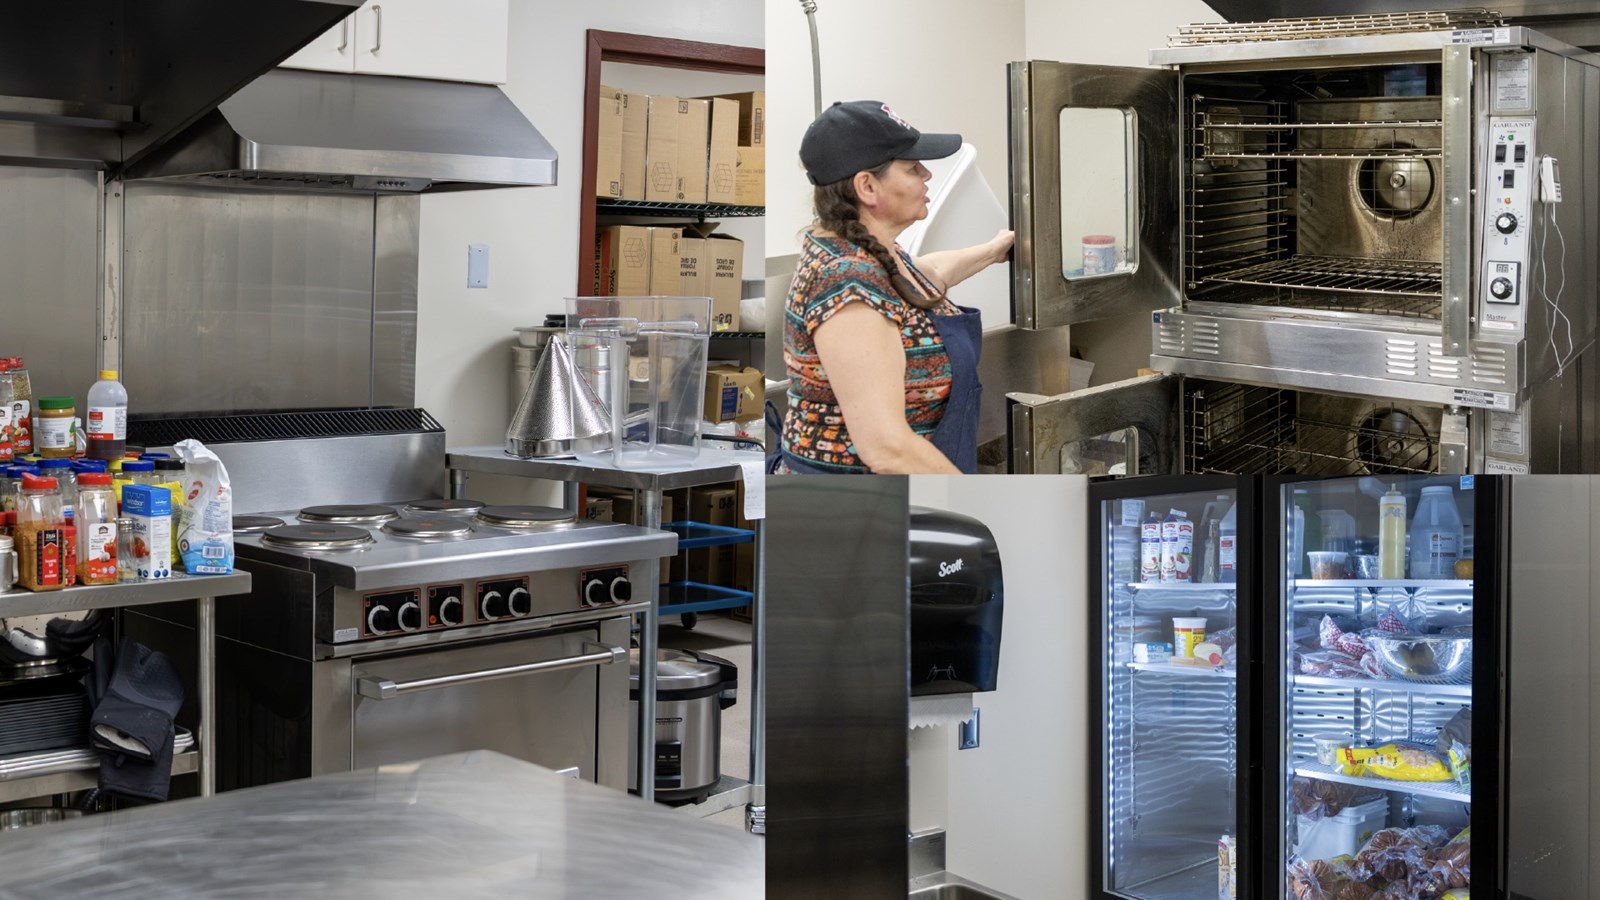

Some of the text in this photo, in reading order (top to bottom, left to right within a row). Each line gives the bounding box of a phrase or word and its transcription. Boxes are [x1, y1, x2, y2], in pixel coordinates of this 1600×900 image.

[608, 270, 616, 293] Sysco
[1488, 464, 1525, 473] GARLAND
[938, 558, 963, 578] Scott
